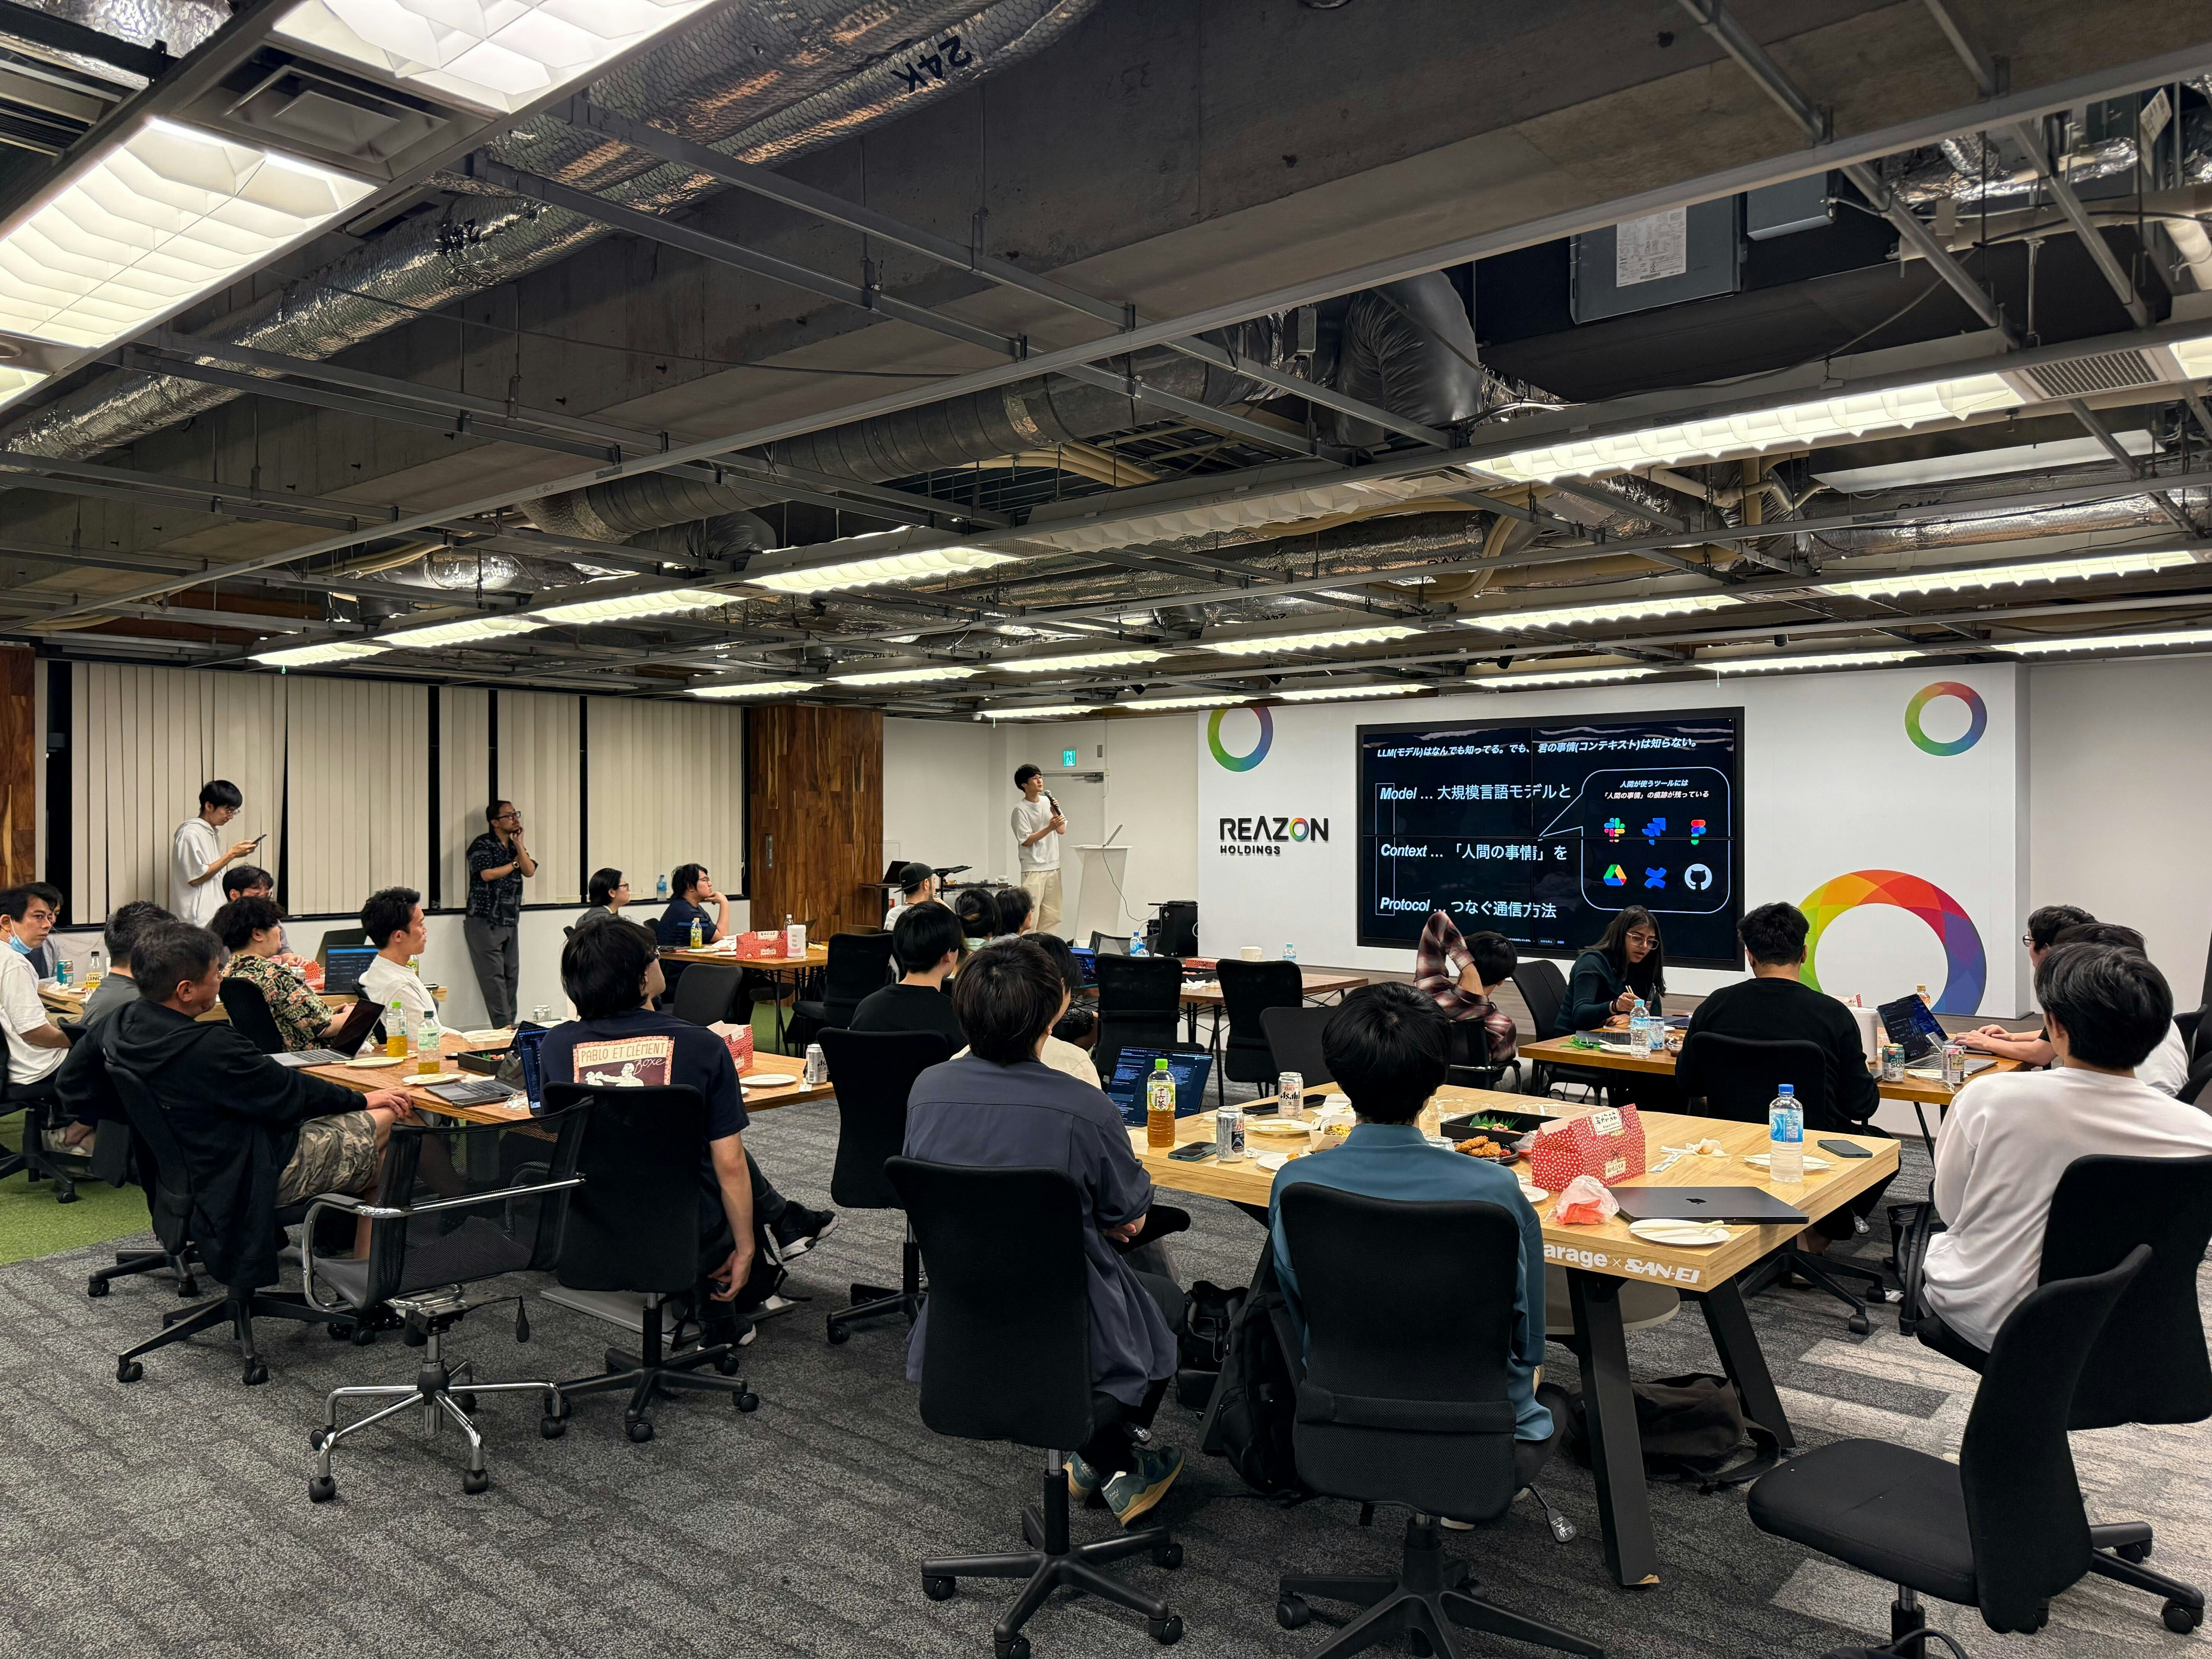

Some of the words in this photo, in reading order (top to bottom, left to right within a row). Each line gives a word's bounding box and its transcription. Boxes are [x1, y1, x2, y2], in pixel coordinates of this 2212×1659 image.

[890, 35, 972, 94] 24K
[1380, 787, 1417, 800] Model
[1437, 784, 1571, 800] 大規模言語モデルと
[1620, 779, 1688, 788] 人間が使うツールには
[1219, 816, 1329, 842] REAZON
[1220, 845, 1281, 855] HOLDINGS
[1381, 843, 1427, 857] Context
[1380, 896, 1430, 912] Protocol
[1451, 900, 1557, 918] つなぐ通信方法
[581, 1048, 608, 1063] PABLO
[613, 1047, 625, 1059] ET
[627, 1043, 666, 1056] CLÉMENT
[1157, 1087, 1166, 1109] 十六茶
[1280, 1091, 1300, 1100] Asahi
[1544, 1243, 1608, 1268] arage
[1624, 1258, 1700, 1283] SAN-EI
